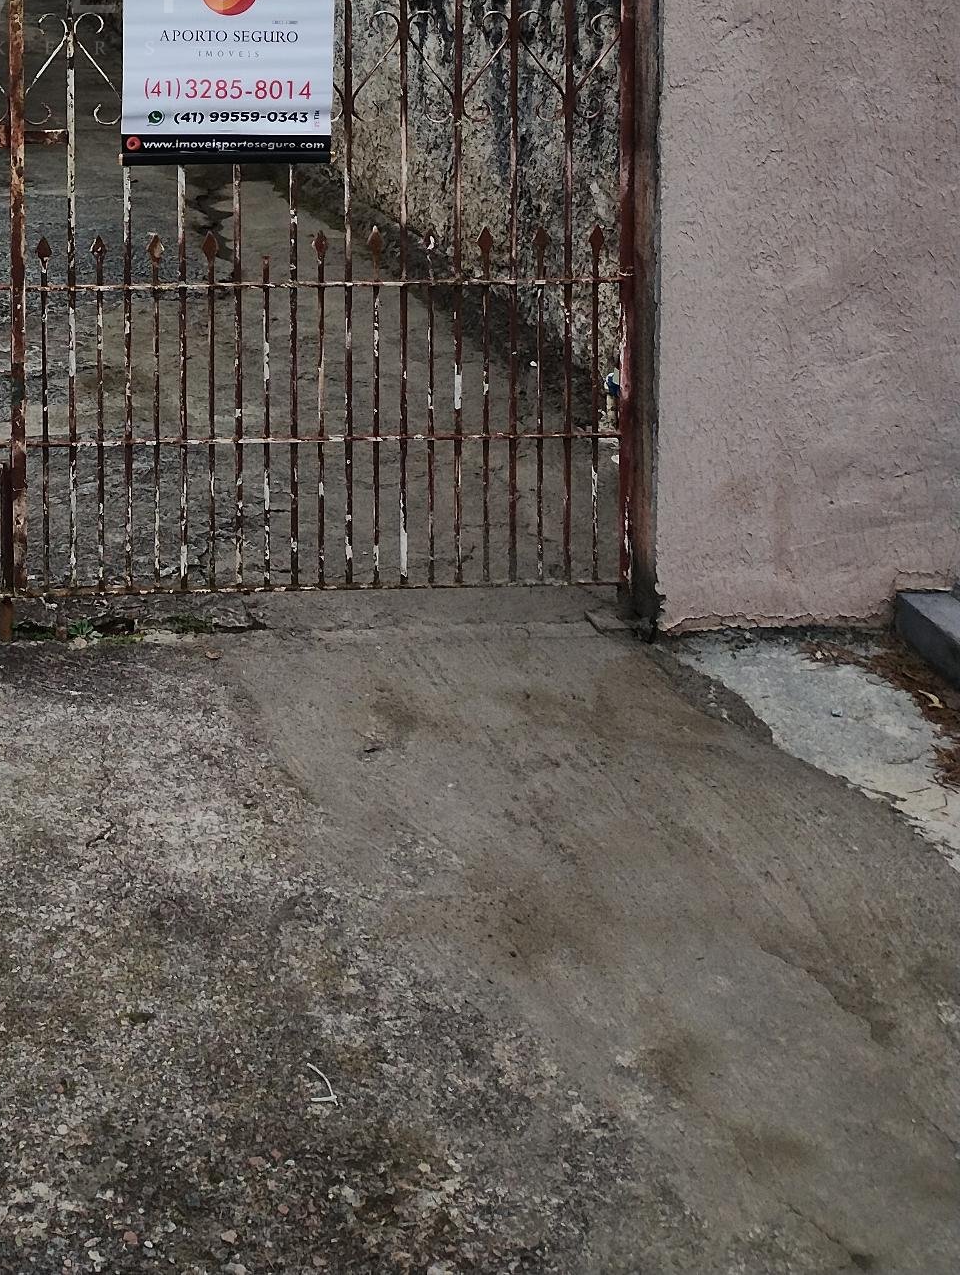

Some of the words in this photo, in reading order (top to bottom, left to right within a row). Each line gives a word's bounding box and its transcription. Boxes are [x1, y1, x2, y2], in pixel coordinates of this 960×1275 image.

[159, 29, 228, 43] APORTO
[233, 29, 299, 44] SEGURO
[173, 110, 205, 124] (41)
[209, 110, 309, 124] 99559-0343
[143, 138, 325, 151] www.imoveisportoseguro.com
